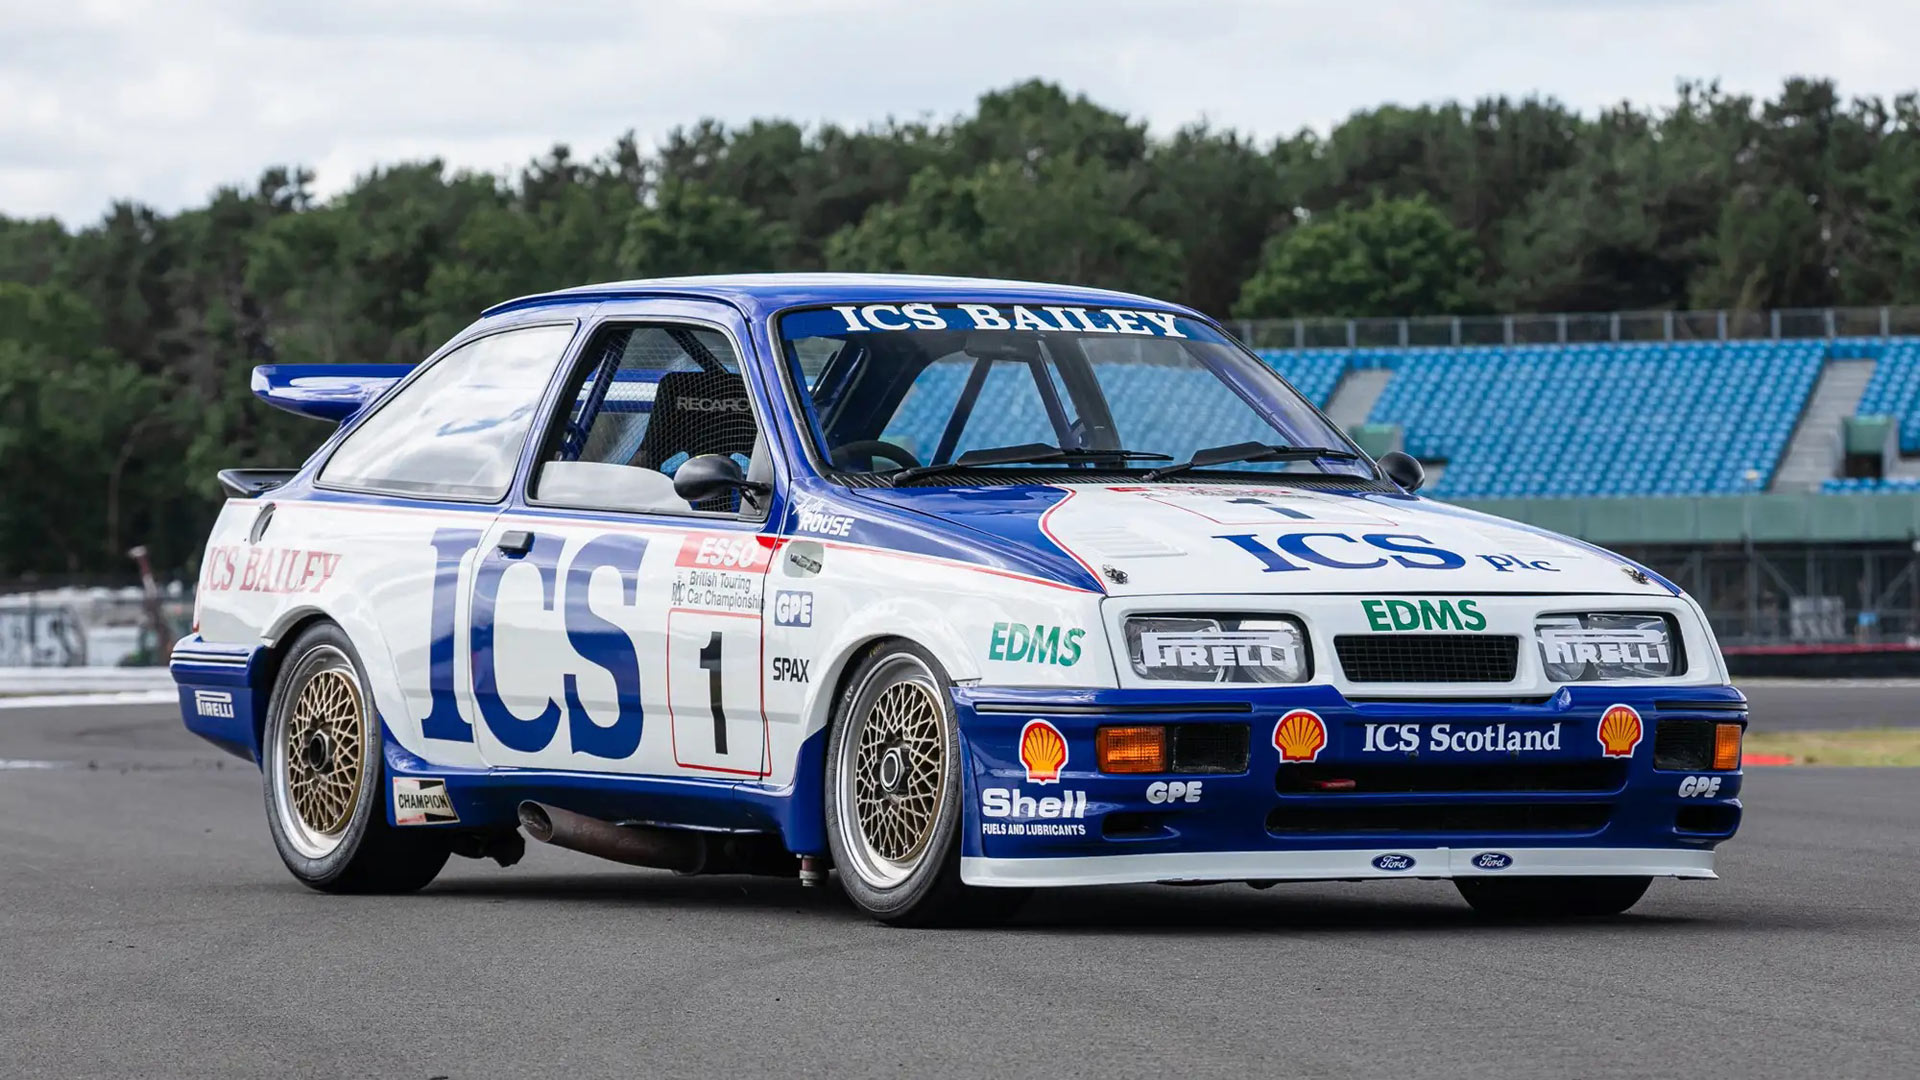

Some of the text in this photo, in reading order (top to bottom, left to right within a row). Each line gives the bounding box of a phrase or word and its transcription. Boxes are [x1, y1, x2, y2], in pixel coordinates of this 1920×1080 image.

[832, 303, 1188, 338] ICS BAILEY
[1224, 497, 1315, 519] 1
[798, 511, 856, 537] ROUSE
[695, 536, 758, 568] ESSO
[1211, 533, 1561, 573] ICS plc
[202, 546, 343, 594] ICS BAILEY
[689, 570, 752, 594] British Touring
[687, 588, 703, 604] Car
[776, 593, 812, 624] GPE
[1360, 599, 1487, 631] EDMS
[421, 527, 649, 760] ICS
[988, 621, 1086, 667] EDMS
[1141, 631, 1300, 667] PIRELLI
[1540, 629, 1670, 664] PIRELLI
[773, 657, 810, 683] SPAX
[194, 689, 234, 718] PIRELLI
[700, 631, 728, 755] 1
[1362, 722, 1562, 752] ICS Scotland
[398, 793, 449, 809] CHAMPION
[1146, 781, 1203, 804] GPE
[1678, 775, 1722, 798] GPE
[982, 788, 1087, 818] Shell
[982, 823, 1087, 836] FUELS AND LUBRICANTS
[1380, 855, 1408, 869] Ford
[1479, 854, 1506, 867] Ford
